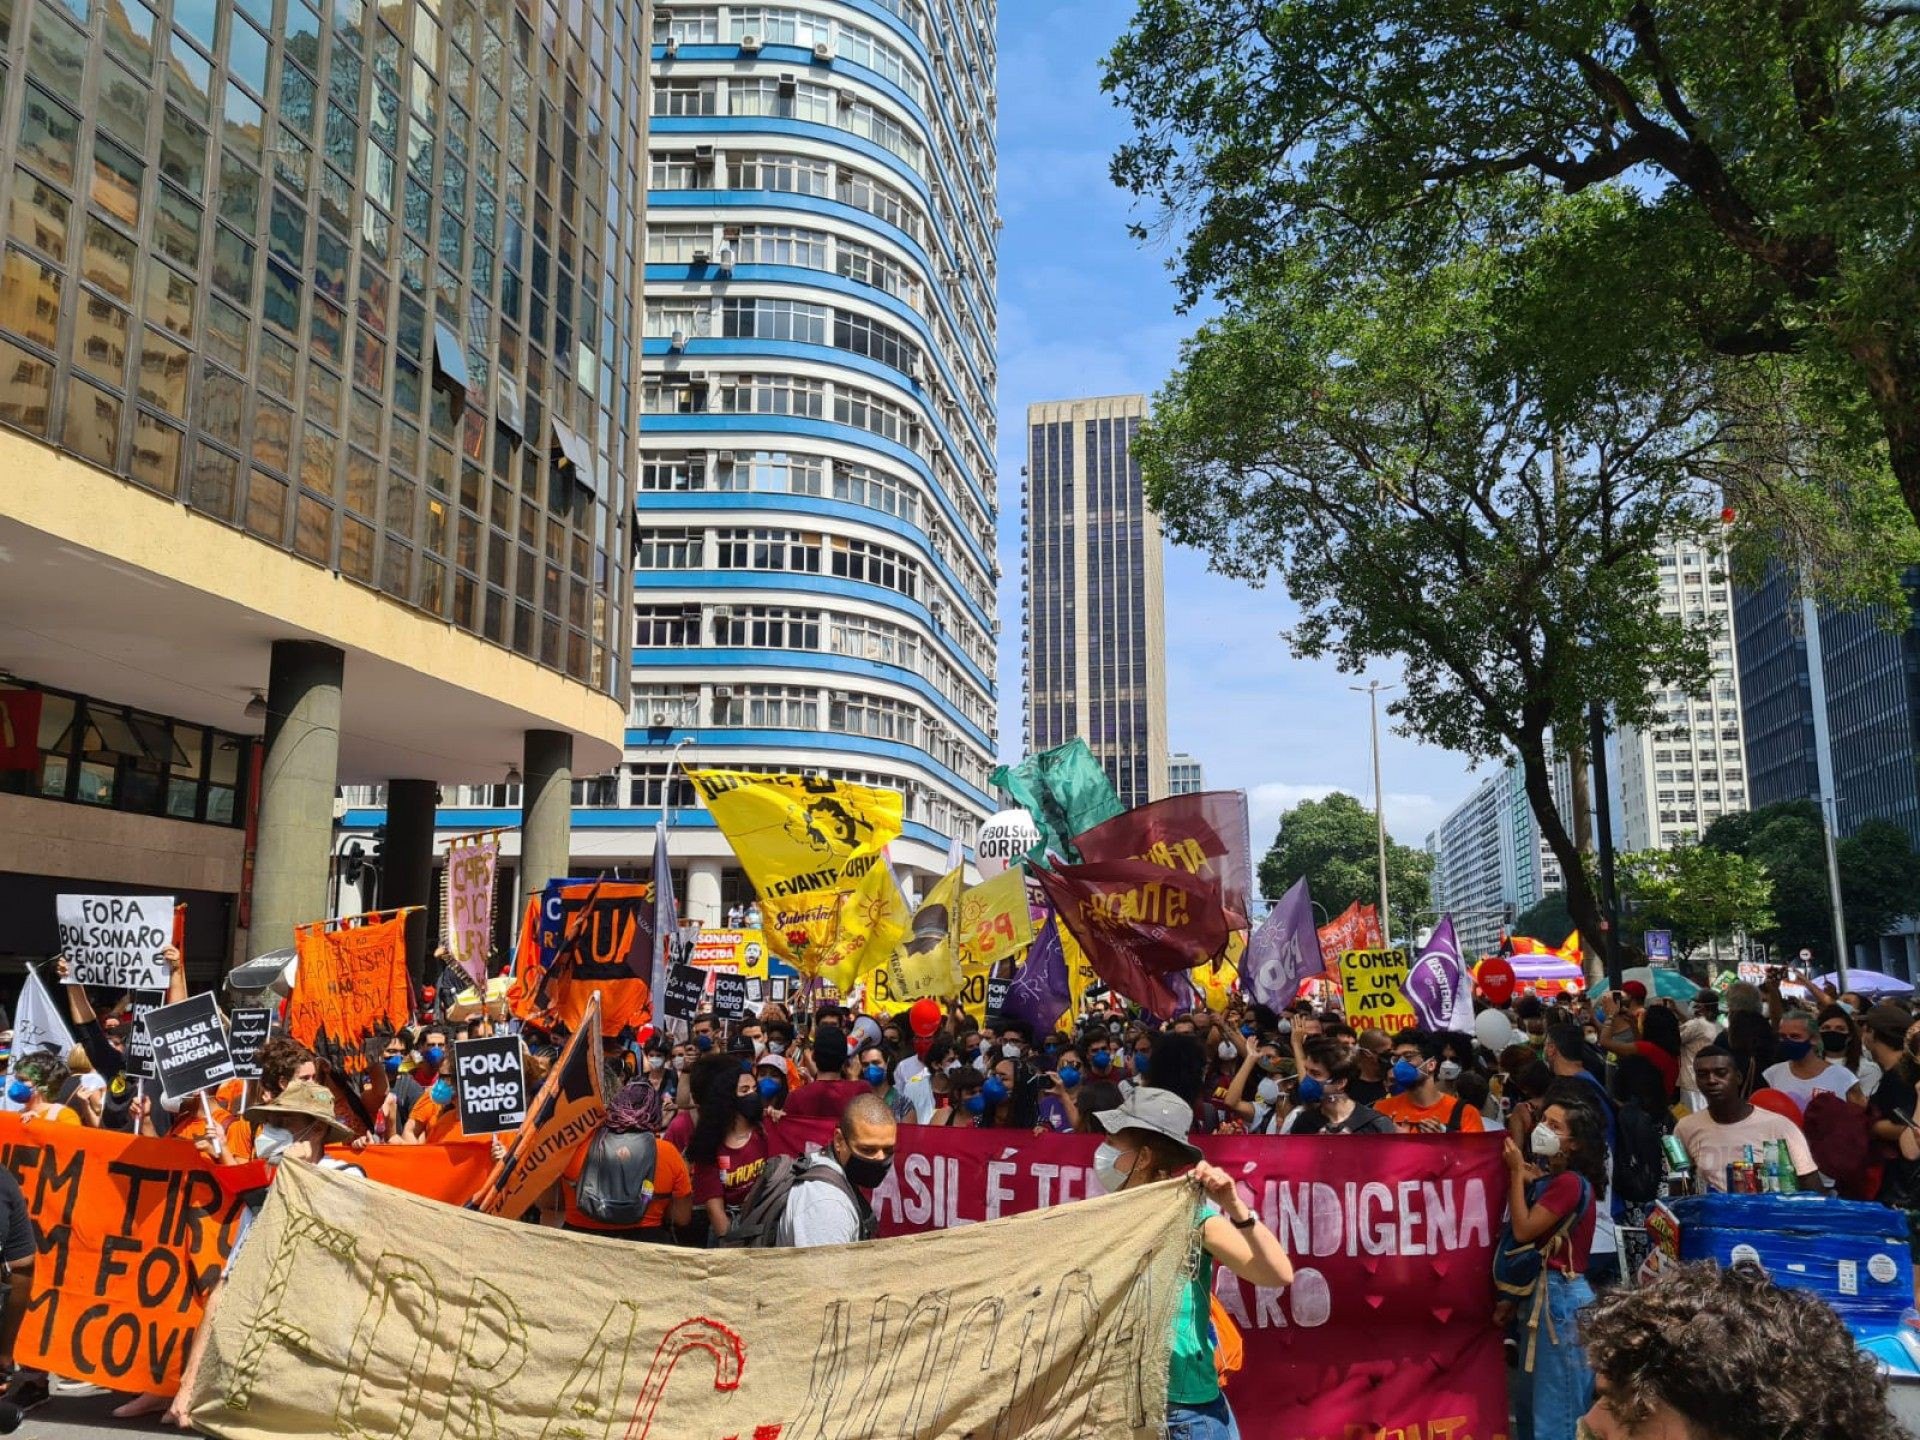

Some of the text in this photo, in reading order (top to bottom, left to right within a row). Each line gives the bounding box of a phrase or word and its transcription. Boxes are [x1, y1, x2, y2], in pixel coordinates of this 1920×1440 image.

[82, 900, 145, 924] FORA
[60, 924, 165, 949] BOLSONARO
[63, 946, 144, 968] GENOCIDA
[1345, 950, 1404, 969] COMER
[74, 964, 155, 986] GOLPISTA
[716, 979, 744, 993] FORA
[1371, 973, 1400, 990] UM
[1359, 991, 1396, 1011] ATO
[153, 1013, 221, 1048] O BRASIL É
[168, 1033, 211, 1056] TERRA
[459, 1051, 520, 1077] FORA
[463, 1076, 519, 1100] bolso
[467, 1095, 517, 1114] naro
[986, 1147, 1018, 1222] É
